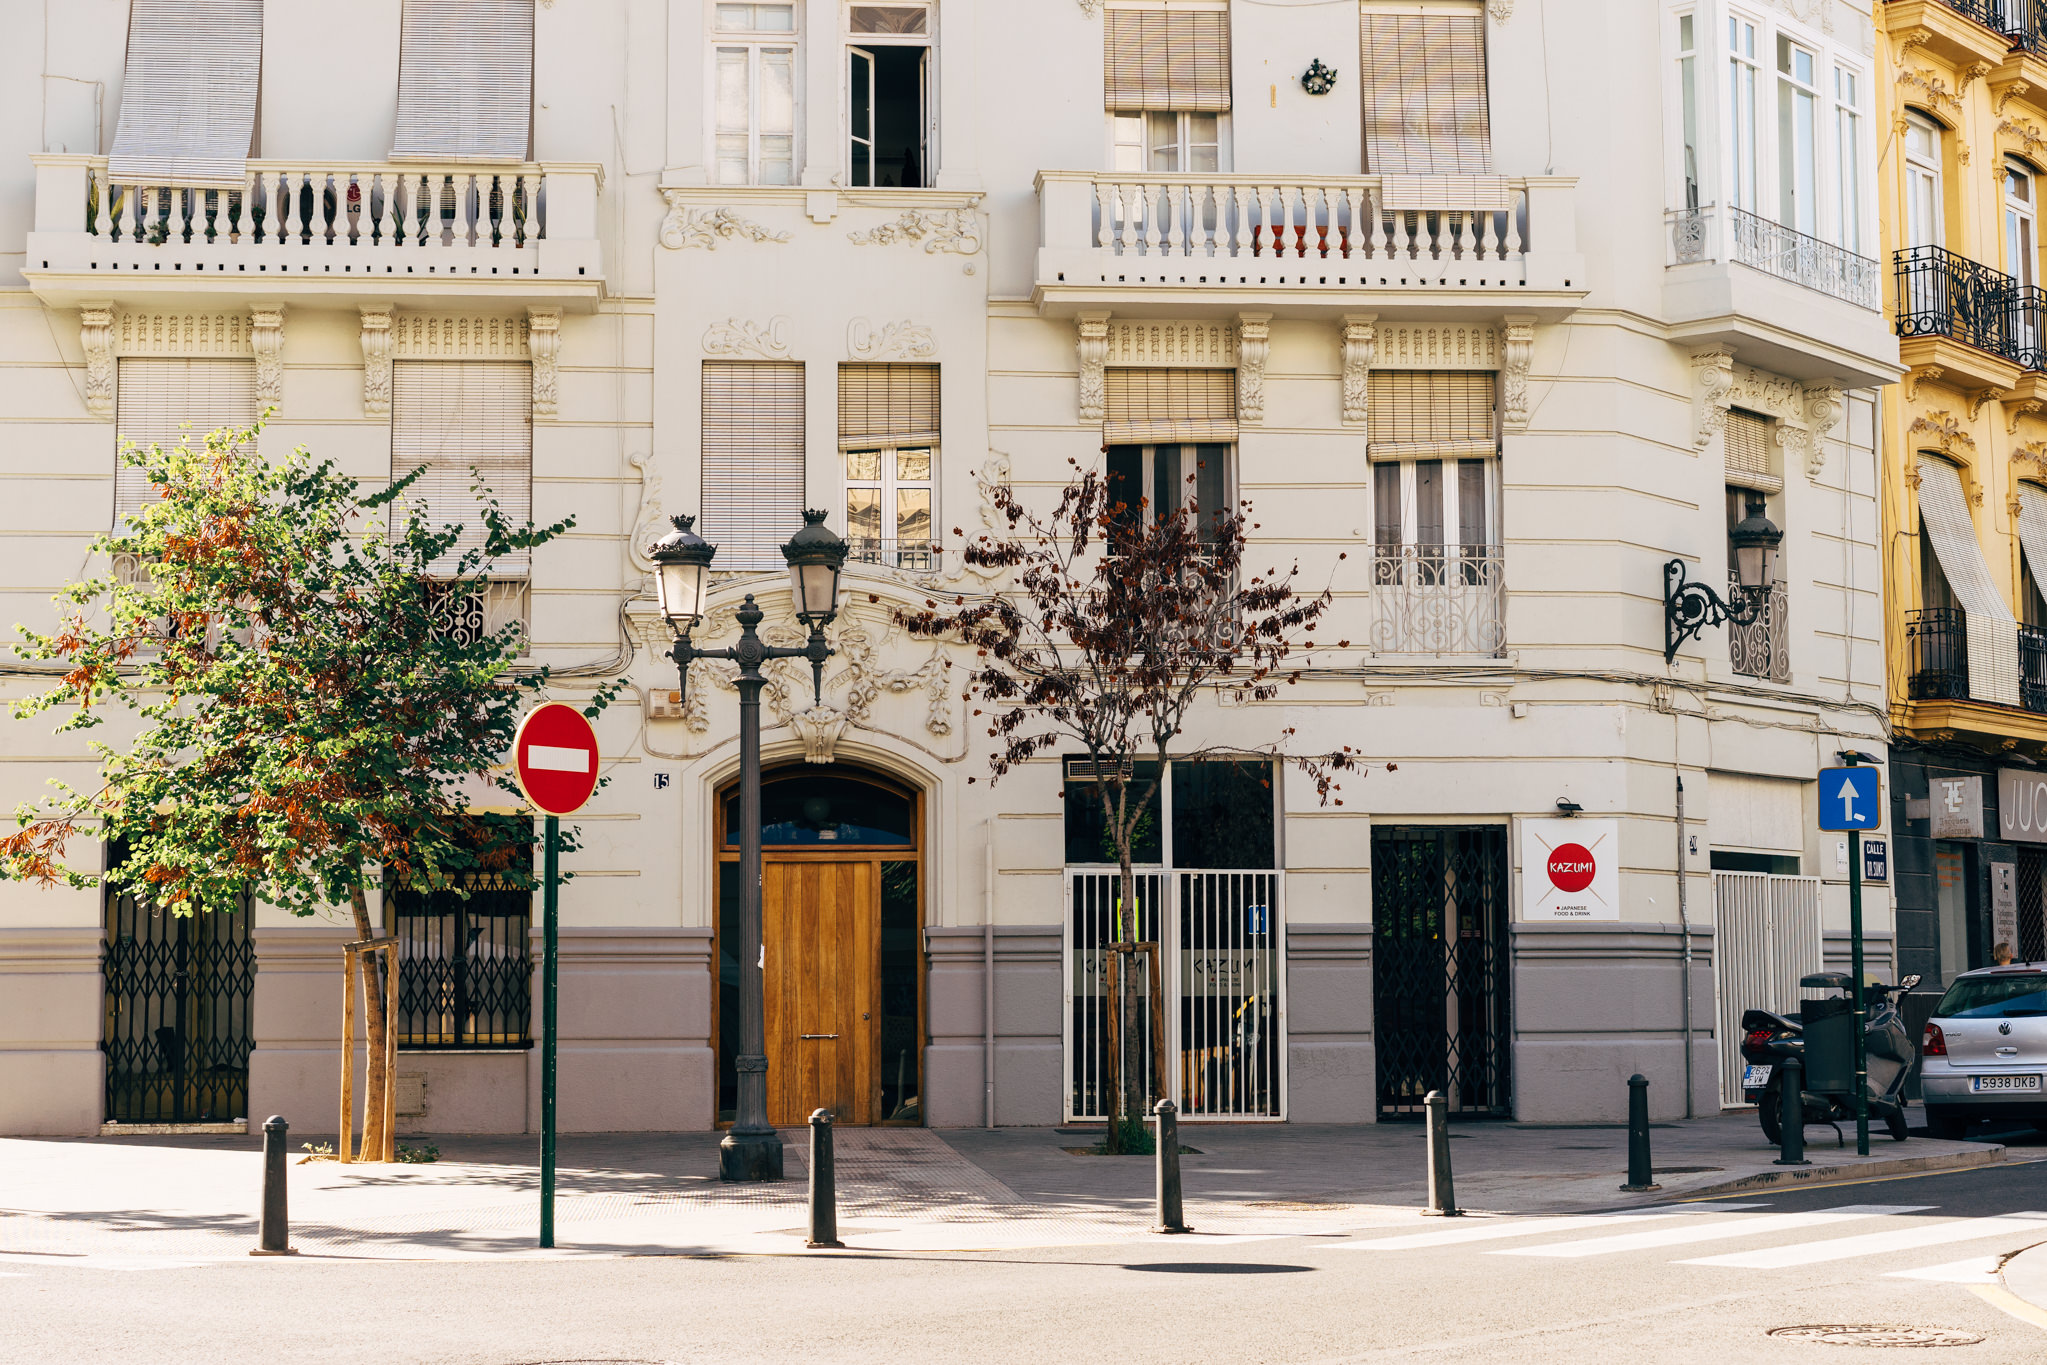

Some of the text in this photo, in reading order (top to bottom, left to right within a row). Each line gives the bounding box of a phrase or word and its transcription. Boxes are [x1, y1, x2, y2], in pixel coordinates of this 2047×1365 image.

[347, 204, 361, 213] LG
[655, 774, 669, 788] 15
[1866, 843, 1884, 855] CALLE
[1550, 862, 1592, 872] KAZUMI
[1193, 958, 1257, 974] KAZUM
[1982, 1077, 2036, 1088] 5938 DKB
